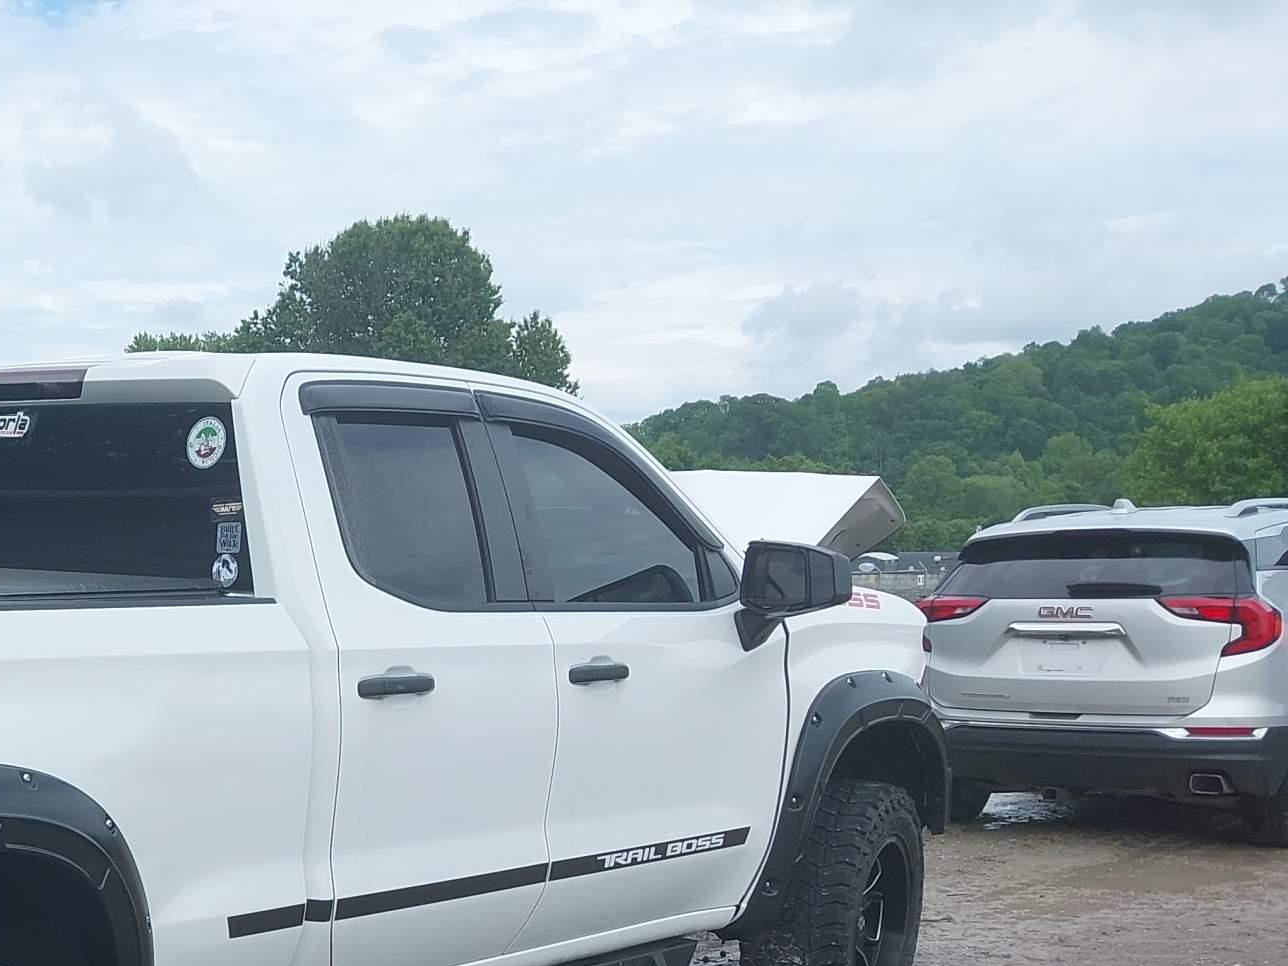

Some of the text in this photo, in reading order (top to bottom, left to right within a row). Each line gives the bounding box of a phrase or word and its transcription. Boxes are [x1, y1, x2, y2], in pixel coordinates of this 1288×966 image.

[1038, 606, 1094, 619] GMC
[597, 832, 725, 869] TRAIL BOSS
